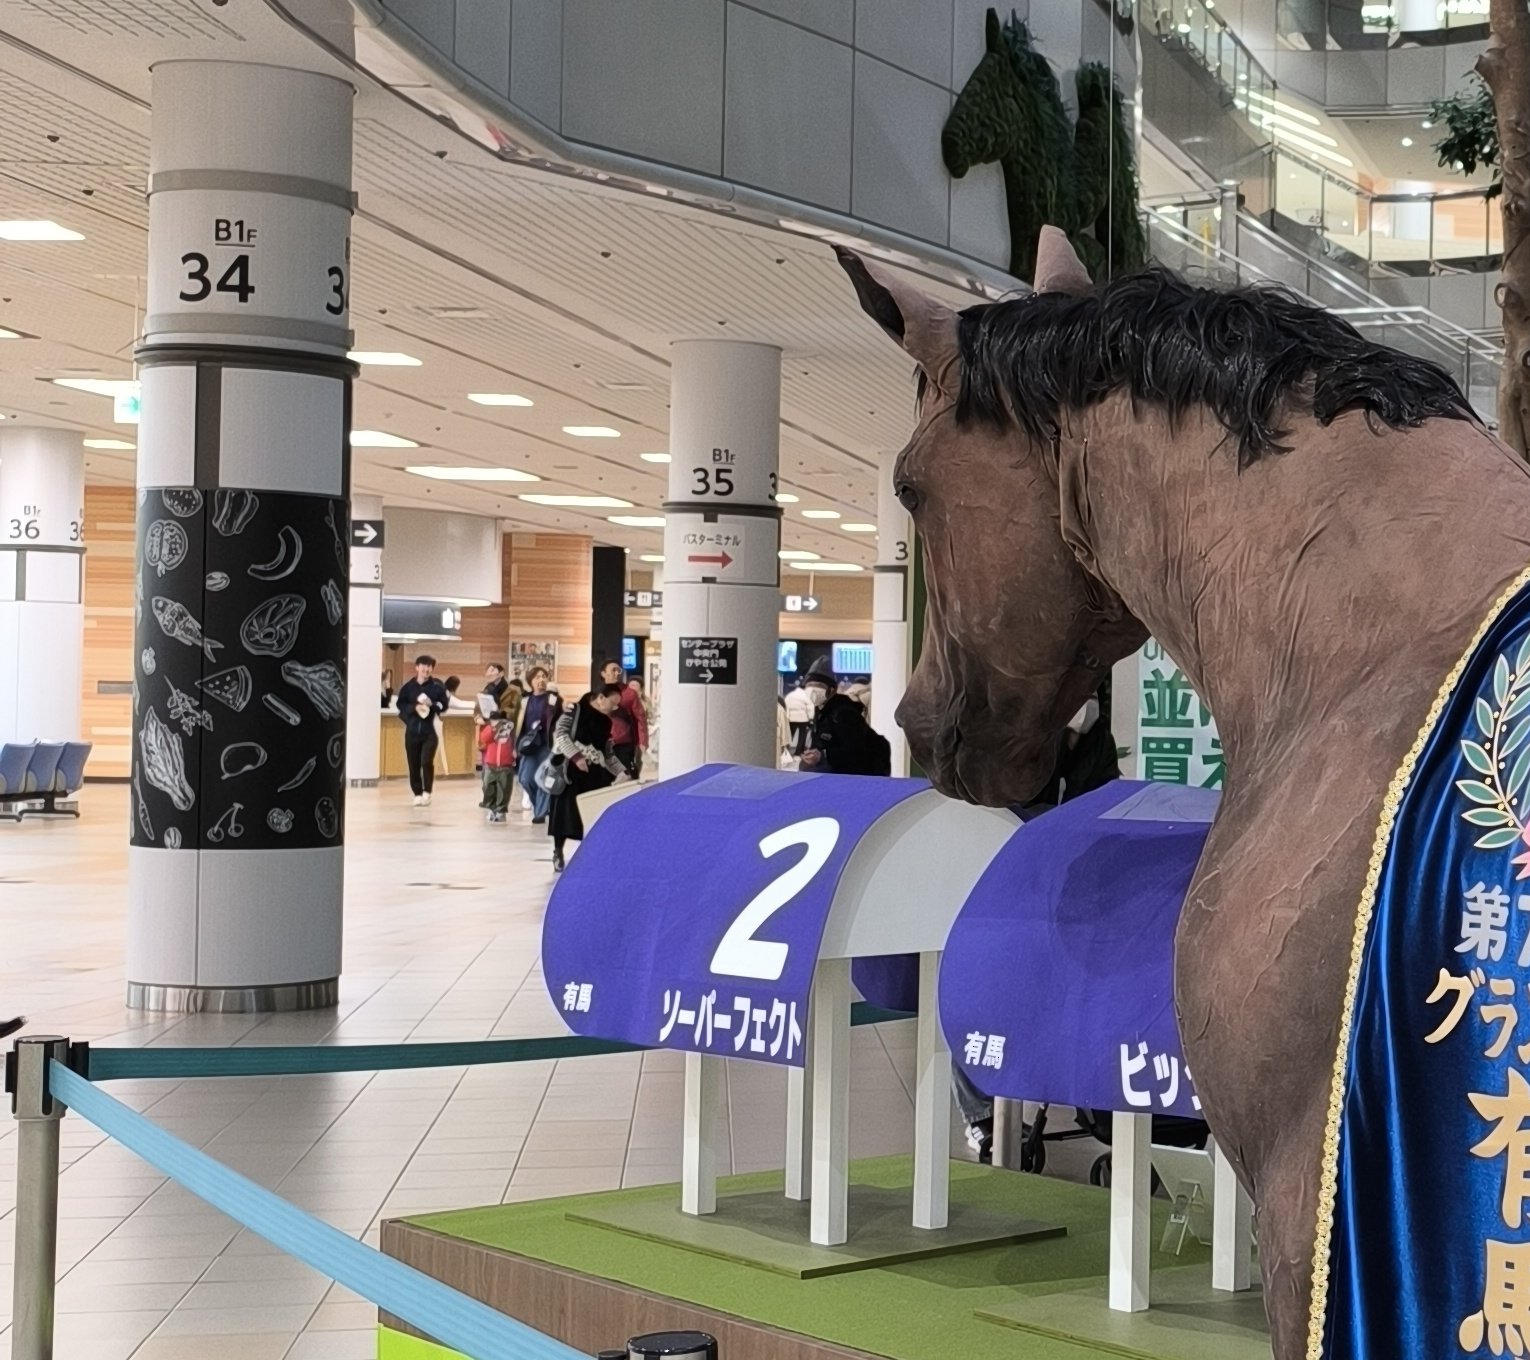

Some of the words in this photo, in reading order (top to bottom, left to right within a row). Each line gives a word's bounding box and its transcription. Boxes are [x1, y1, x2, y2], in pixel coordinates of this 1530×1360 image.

[214, 218, 258, 243] B1F
[179, 252, 256, 303] 34
[325, 266, 350, 315] 3
[712, 448, 736, 463] B1F
[691, 467, 735, 497] 35
[9, 519, 41, 540] 36
[683, 532, 742, 548] バスターミナル
[709, 816, 840, 981] 2
[964, 1030, 1007, 1070] 有馬
